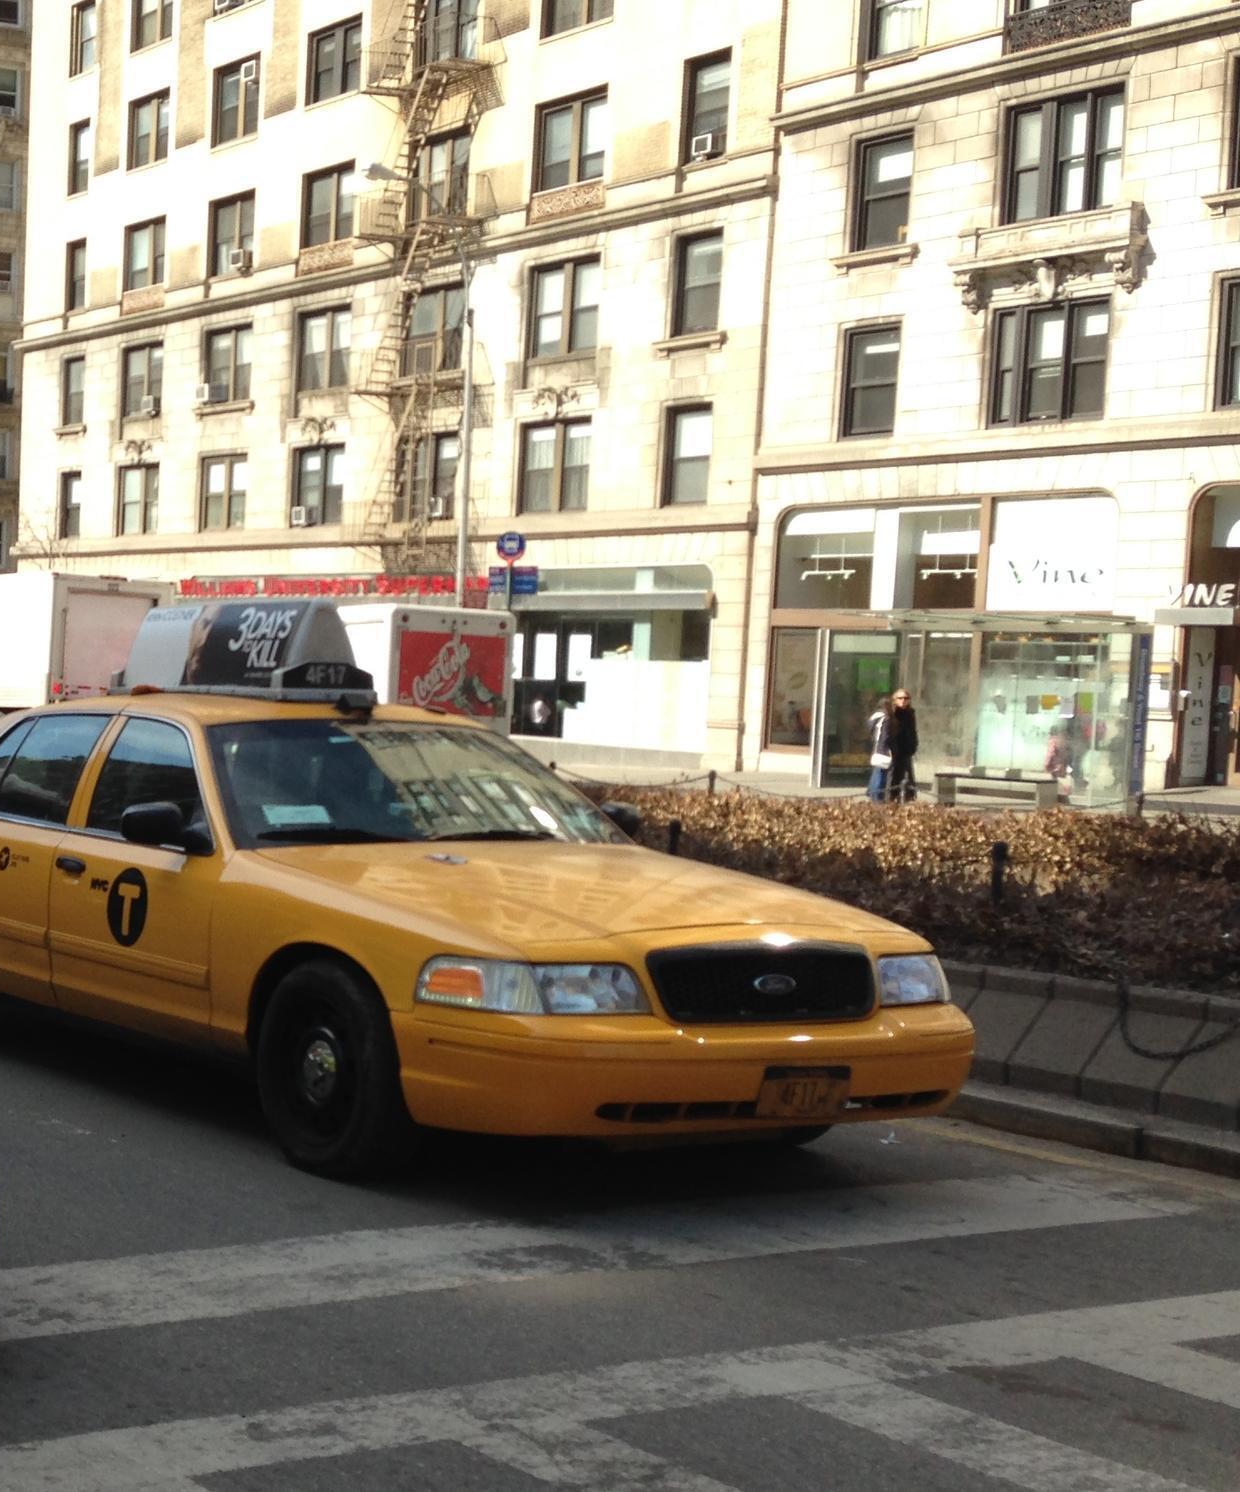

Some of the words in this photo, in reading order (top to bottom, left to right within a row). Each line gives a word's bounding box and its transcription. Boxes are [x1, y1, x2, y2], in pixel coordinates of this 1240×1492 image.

[1168, 582, 1237, 607] VINE
[246, 640, 280, 669] KILL
[305, 665, 346, 684] 4F17
